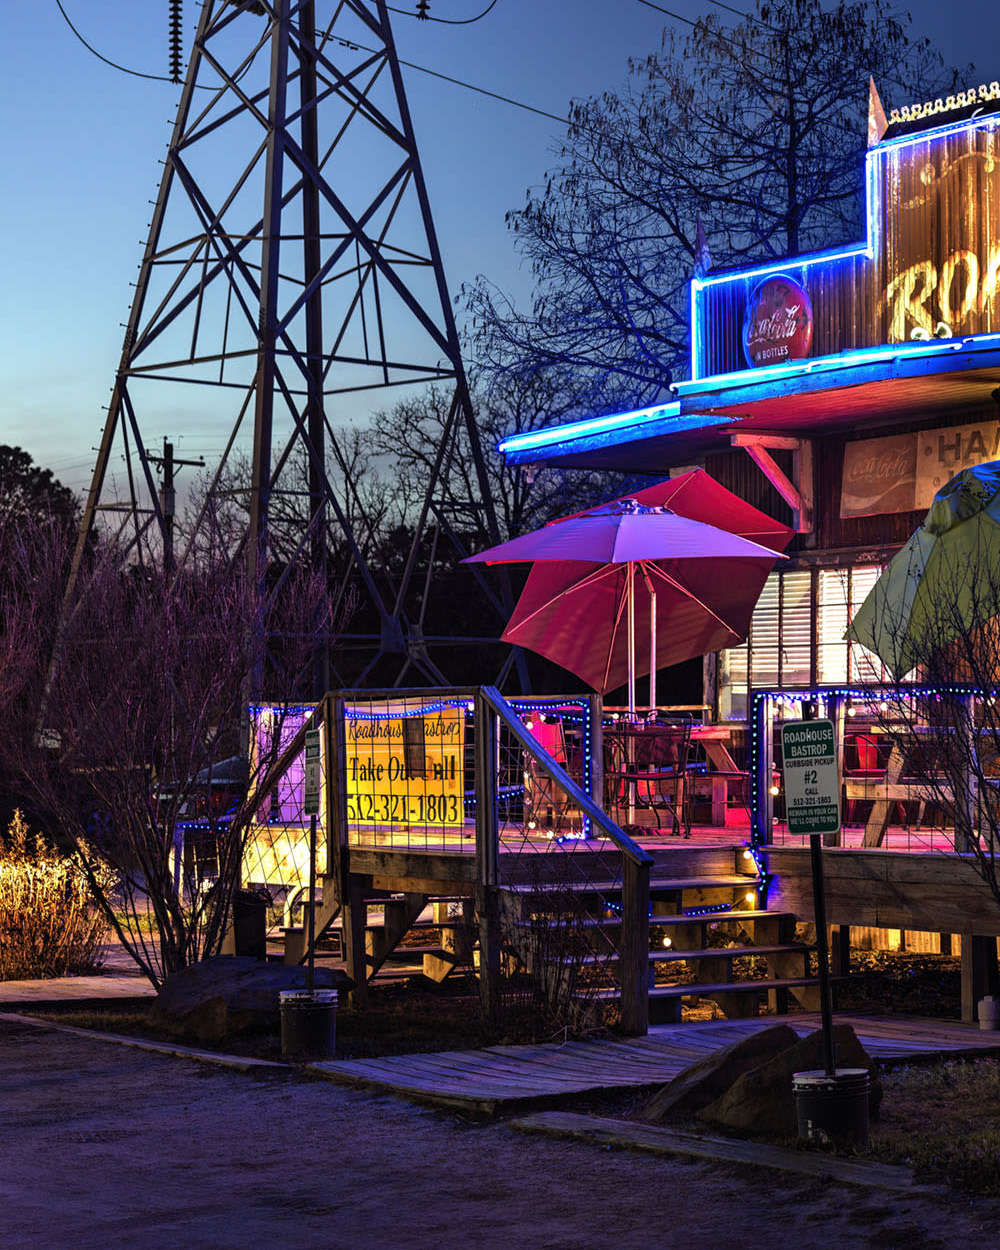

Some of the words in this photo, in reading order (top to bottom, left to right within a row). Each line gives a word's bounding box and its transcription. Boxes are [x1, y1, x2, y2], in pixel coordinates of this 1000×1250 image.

[762, 345, 789, 360] BOTTLES
[349, 718, 403, 741] Roadhous
[784, 729, 833, 744] ROADHOUSE
[791, 743, 828, 757] BASTROP
[349, 756, 384, 781] Take
[785, 759, 814, 768] CURBSIDE
[814, 757, 835, 766] PICKUP
[804, 770, 818, 784] #2
[805, 788, 819, 796] CALL
[347, 793, 458, 823] 512-321-1803
